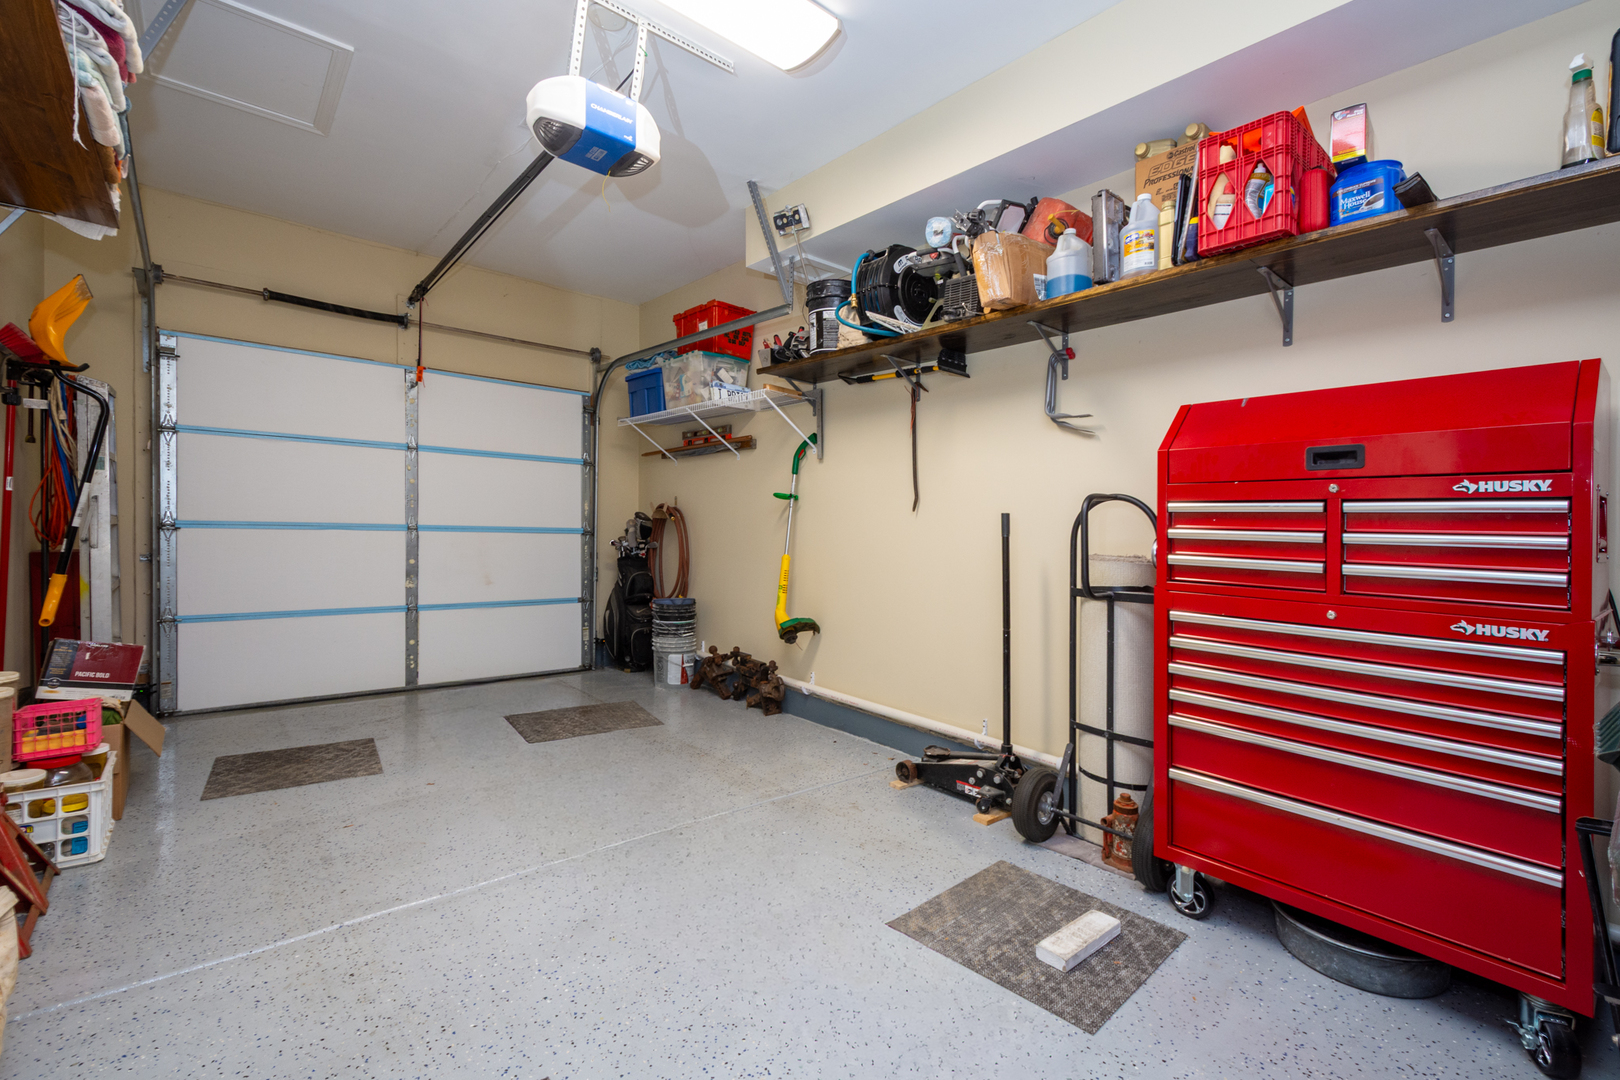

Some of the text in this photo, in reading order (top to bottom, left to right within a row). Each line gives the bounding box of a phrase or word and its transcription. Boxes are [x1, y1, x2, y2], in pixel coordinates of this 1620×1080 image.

[590, 103, 633, 124] CHAMBERLAIN
[1174, 144, 1195, 157] Castrol
[1148, 153, 1196, 178] EDGE
[1143, 166, 1194, 189] PROFESSIONA
[1340, 190, 1371, 205] Maxwell
[1343, 198, 1367, 210] House
[1478, 479, 1553, 493] HUSKY
[1475, 623, 1550, 642] HUSKY
